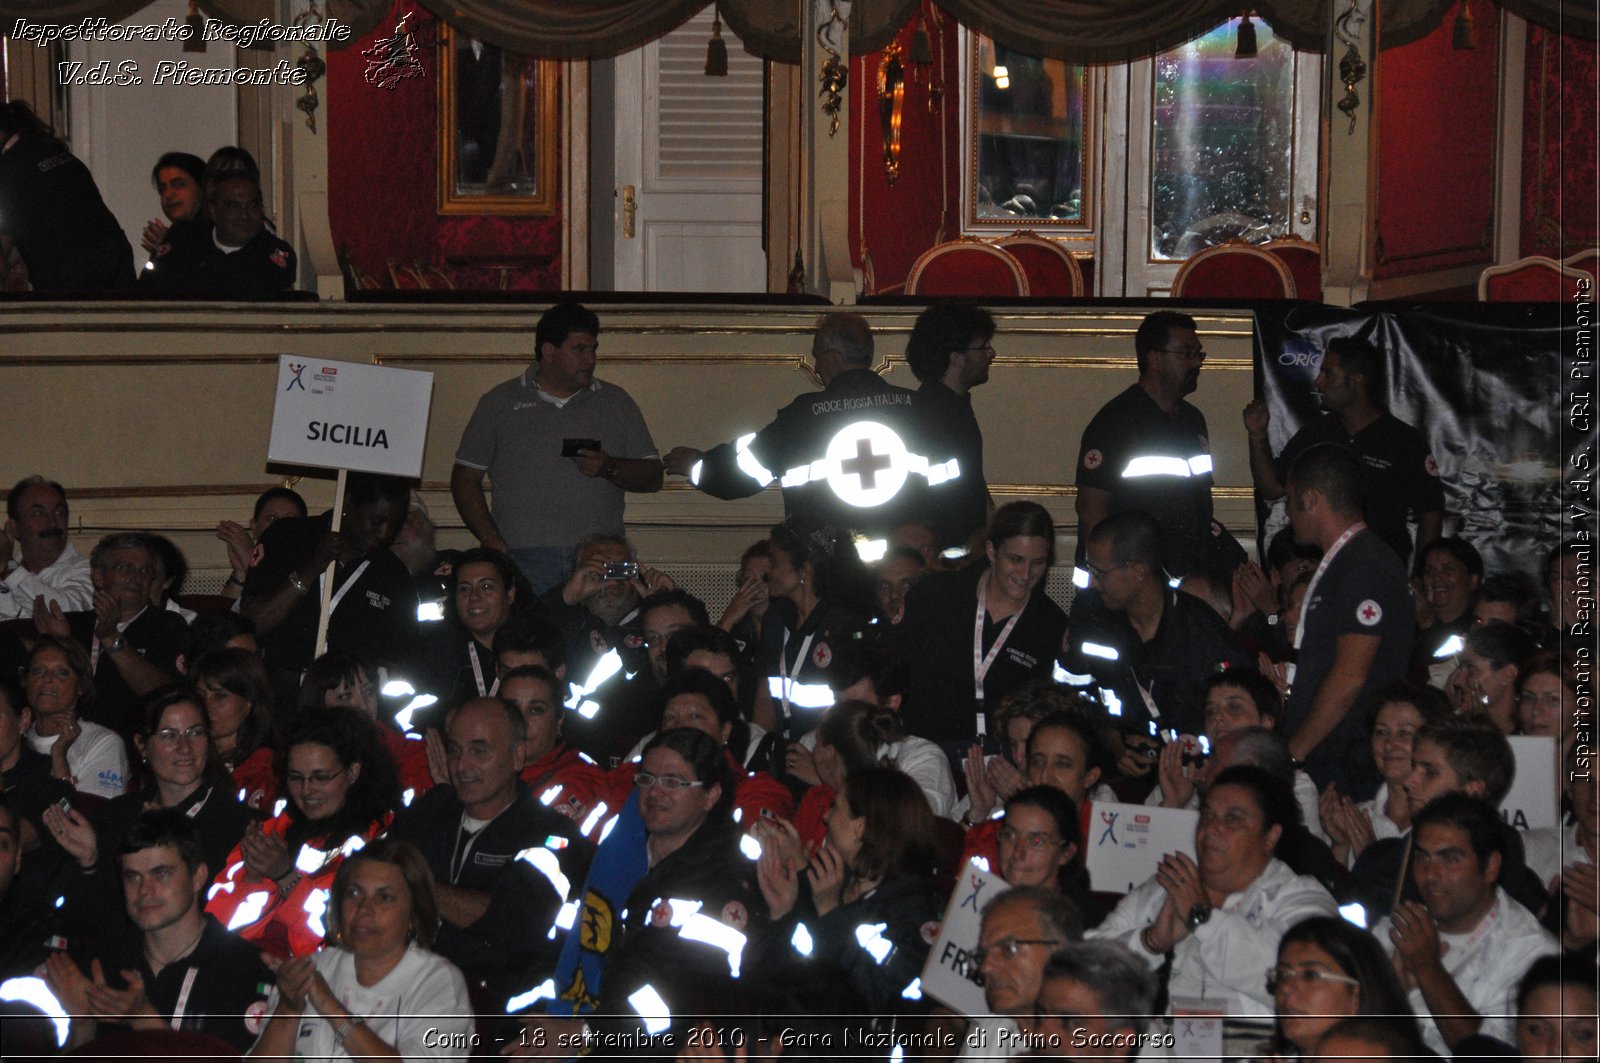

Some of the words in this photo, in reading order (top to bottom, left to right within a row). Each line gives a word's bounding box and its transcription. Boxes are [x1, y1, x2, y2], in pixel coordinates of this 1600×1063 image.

[812, 400, 842, 416] CROCE
[843, 396, 873, 410] ROSSA
[306, 421, 389, 449] SICILIA
